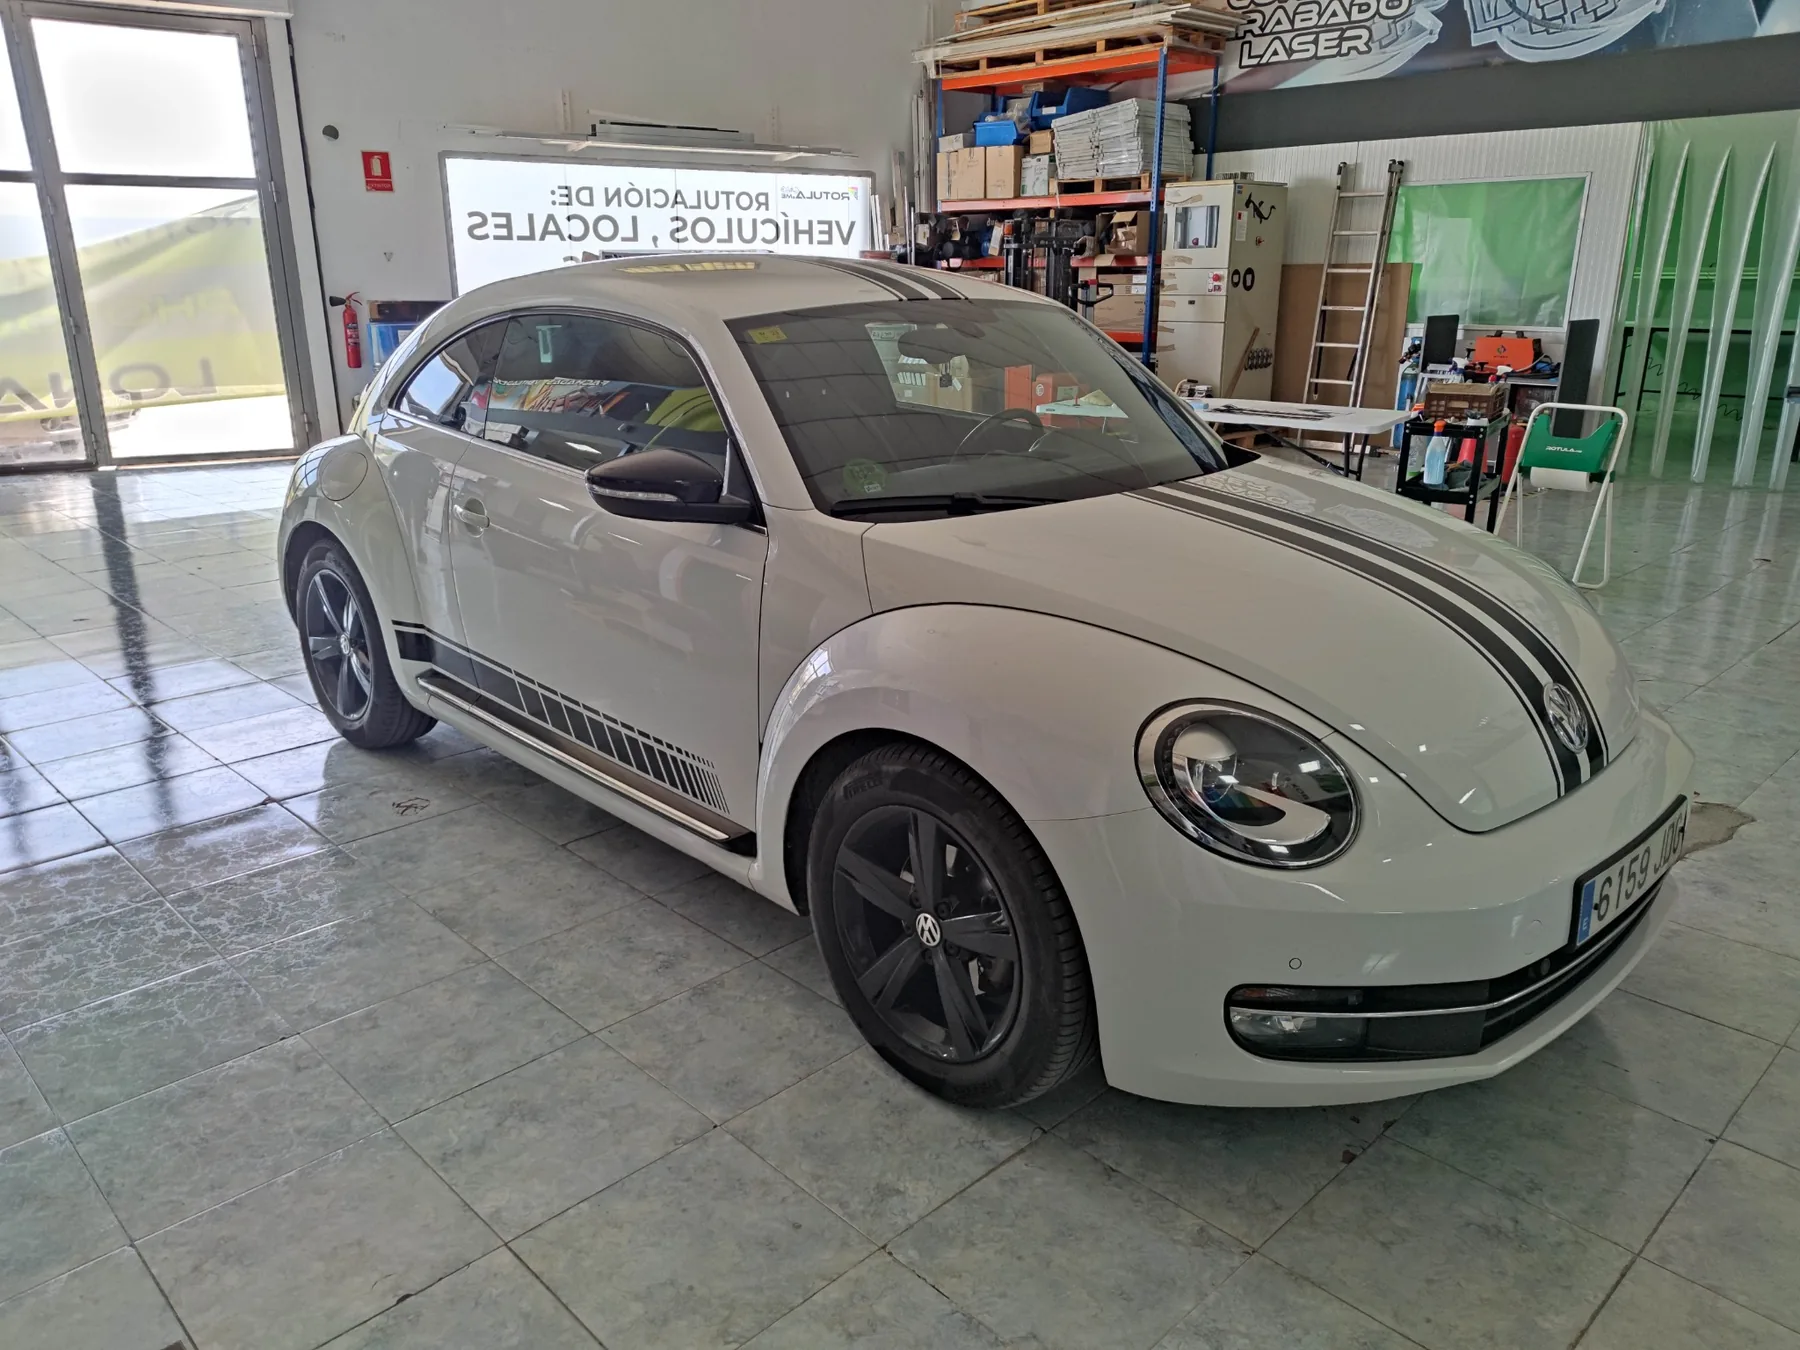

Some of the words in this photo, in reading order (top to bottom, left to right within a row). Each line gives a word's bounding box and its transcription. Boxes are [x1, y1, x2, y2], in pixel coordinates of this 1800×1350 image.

[1231, 0, 1411, 38] RABADO
[1239, 24, 1373, 68] LASER
[1597, 845, 1651, 922] 6159
